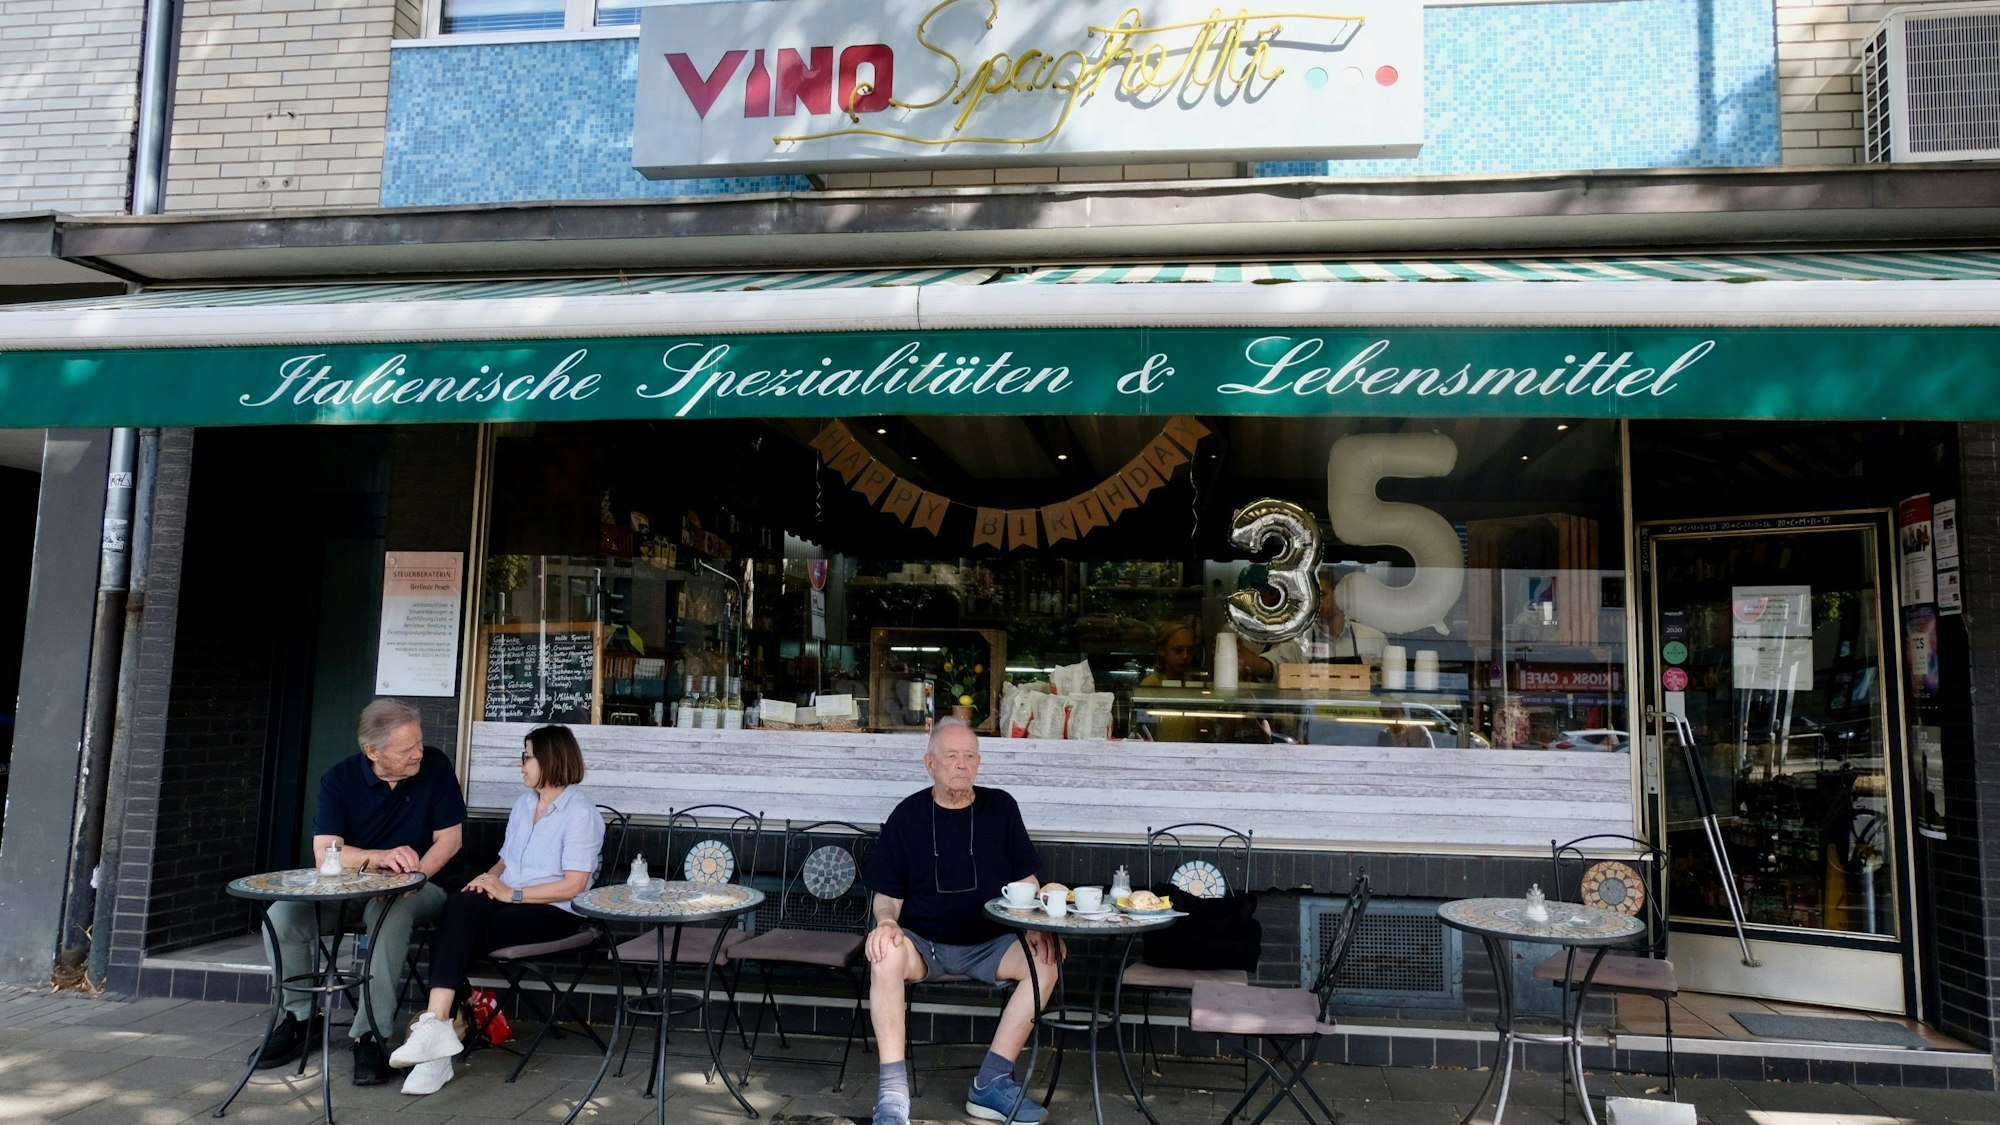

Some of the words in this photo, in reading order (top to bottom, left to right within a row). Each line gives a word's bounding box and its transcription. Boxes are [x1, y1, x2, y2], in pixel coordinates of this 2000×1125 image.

[240, 348, 602, 407] Italienische
[636, 341, 1074, 417] Spezialitäten
[1117, 353, 1175, 395] &
[1217, 336, 1717, 397] Lebensmittel
[823, 428, 942, 521] HAPPY
[982, 418, 1197, 537] BIRTHDAY
[393, 571, 451, 579] STEUERBERATERIN
